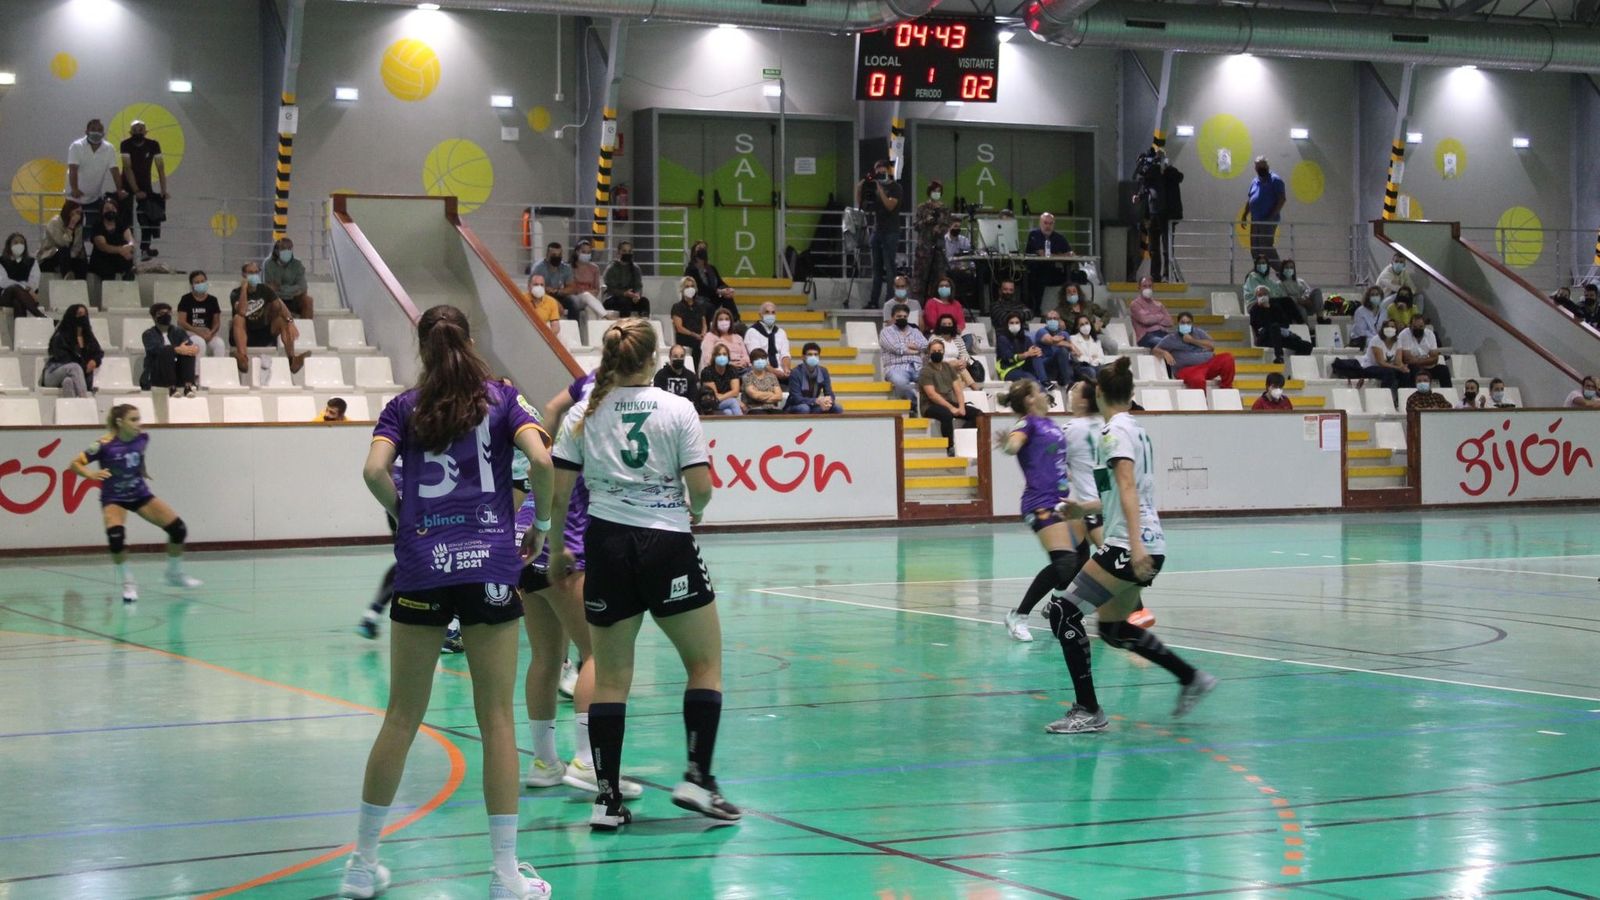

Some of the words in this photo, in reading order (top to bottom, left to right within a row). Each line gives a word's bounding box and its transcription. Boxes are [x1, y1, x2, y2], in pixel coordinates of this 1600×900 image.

[864, 55, 902, 67] LOCAL
[958, 57, 995, 69] VISITANTE
[928, 68, 935, 83] 1
[869, 73, 902, 97] 01
[962, 75, 994, 99] 02
[915, 88, 942, 99] PERIODO
[976, 143, 996, 209] SAL
[734, 133, 756, 275] SALIDA
[614, 400, 658, 412] ZHUKOVA
[620, 411, 651, 469] 3
[124, 451, 141, 468] 10
[708, 428, 852, 493] ixón
[1456, 417, 1593, 496] gijón
[424, 513, 465, 528] blinca
[456, 550, 490, 560] SPAIN
[456, 559, 482, 570] 2021
[672, 580, 688, 593] ASA
